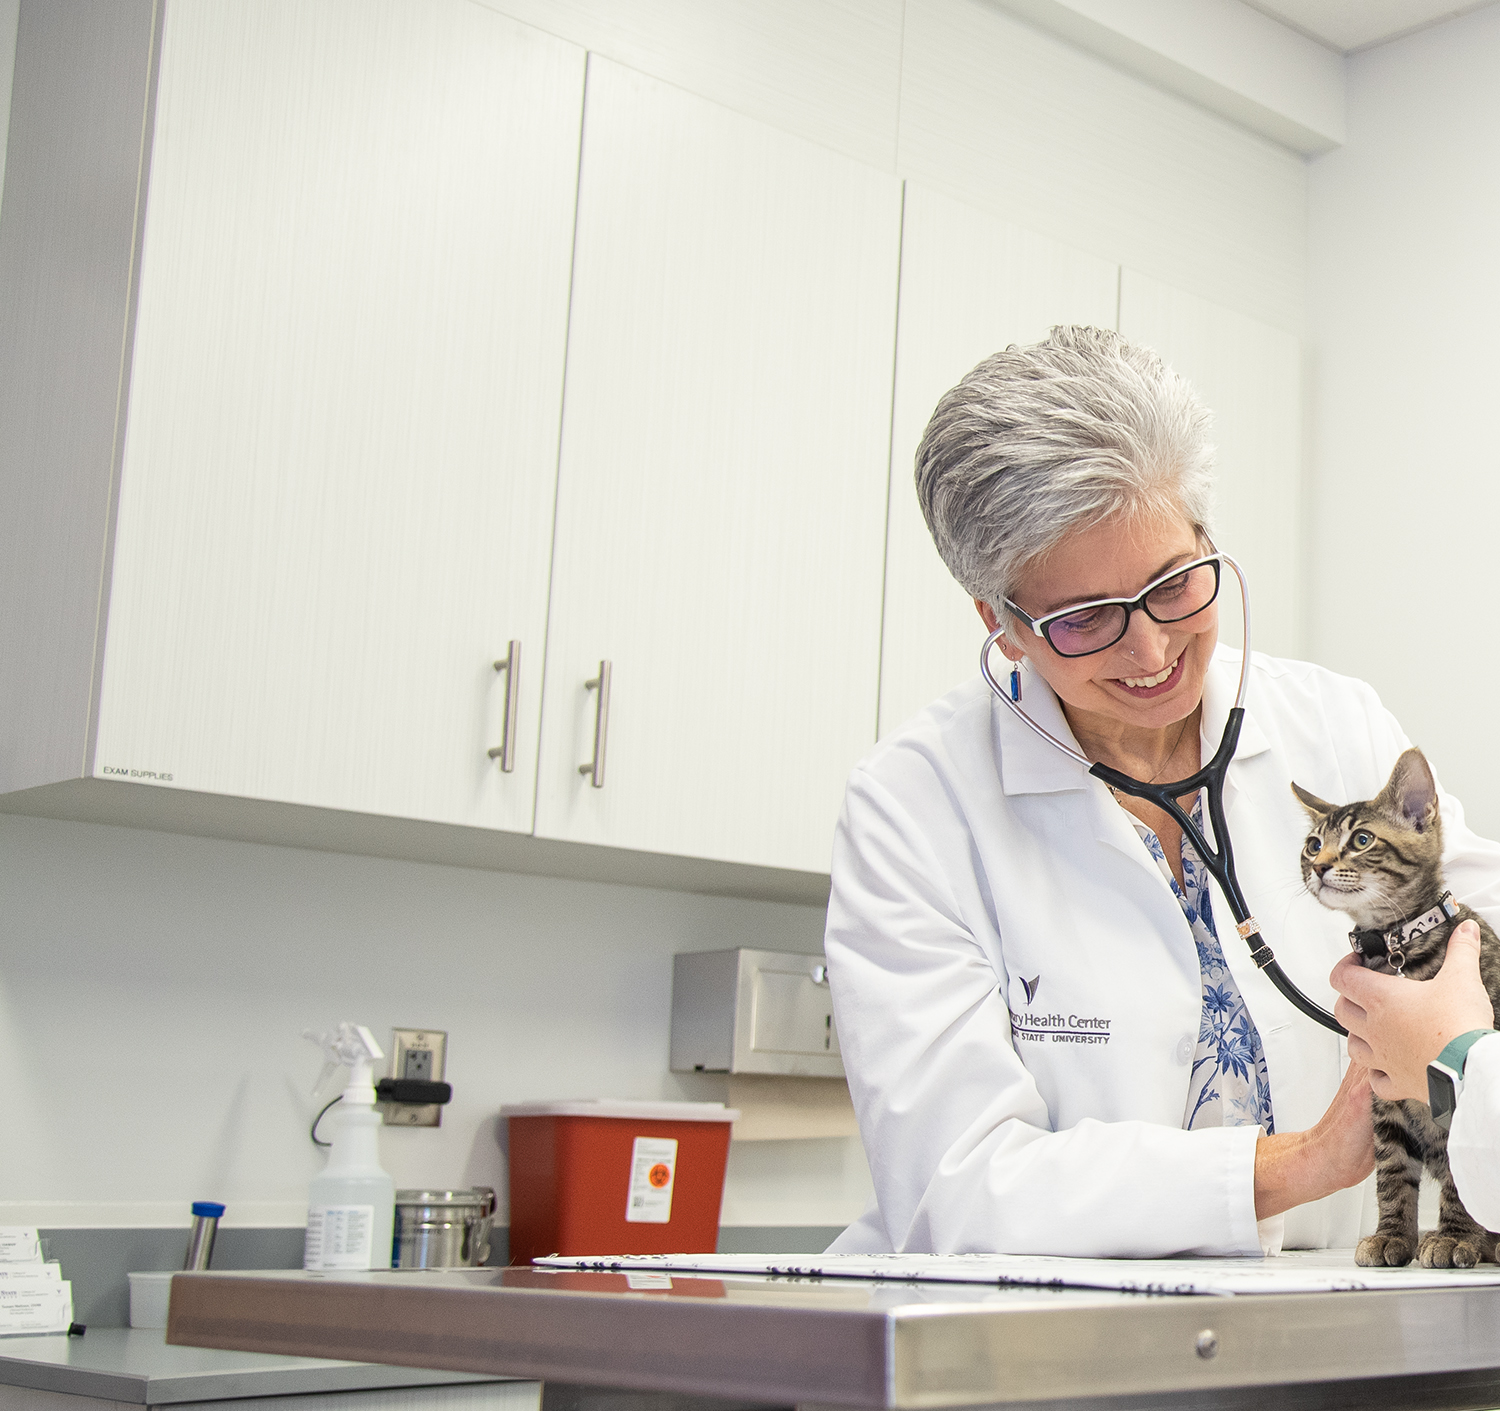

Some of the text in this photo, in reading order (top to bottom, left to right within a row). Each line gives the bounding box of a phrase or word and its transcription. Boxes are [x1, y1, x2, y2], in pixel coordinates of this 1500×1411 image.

[103, 766, 174, 781] EXAM SUPPLIES
[1024, 1013, 1066, 1027] Health
[1068, 1014, 1111, 1029] Center
[1021, 1033, 1045, 1042] STATE
[1052, 1035, 1110, 1044] UNIVERSITY
